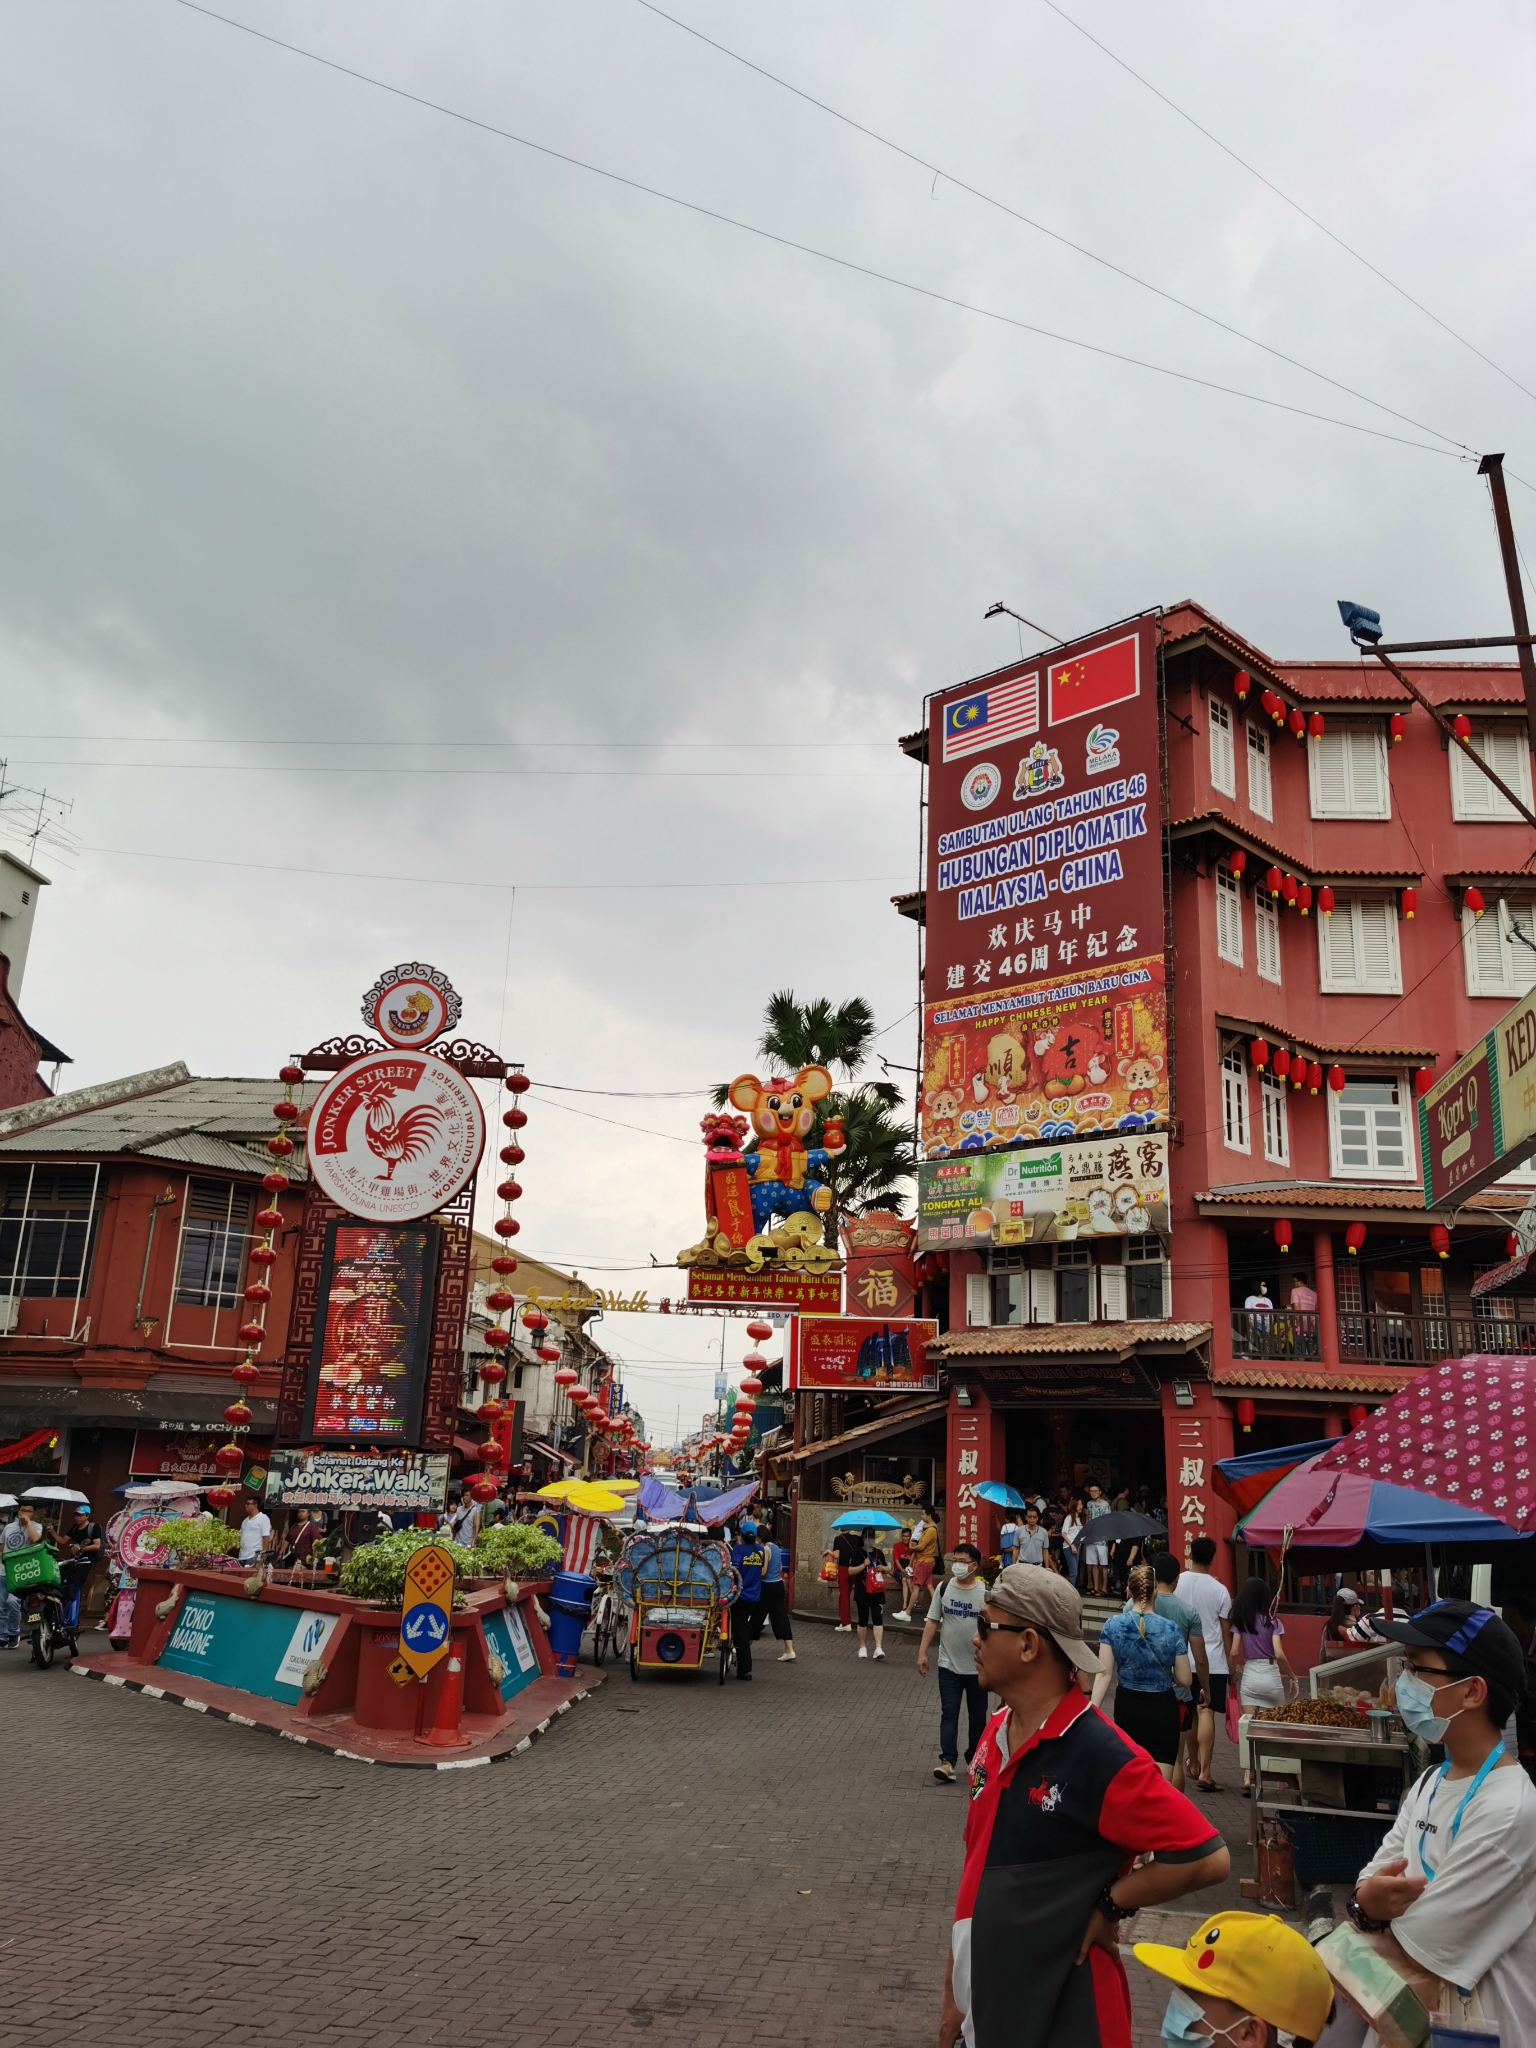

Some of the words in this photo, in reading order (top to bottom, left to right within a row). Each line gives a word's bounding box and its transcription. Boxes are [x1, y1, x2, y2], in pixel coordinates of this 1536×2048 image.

[1089, 751, 1117, 764] MELAKA
[939, 817, 1006, 854] SAMBUTAN
[1009, 804, 1053, 833] ULANG
[1055, 788, 1103, 820] TAHUN
[1106, 781, 1125, 805] KE
[1128, 775, 1145, 796] 46
[939, 838, 1031, 889] HUBUNGAN
[1036, 805, 1146, 862] DIPLOMATIK
[959, 871, 1046, 918] MALAYSIA
[1061, 851, 1122, 891] CHINA
[987, 903, 1092, 950] 欢庆马中
[934, 1005, 980, 1024] SELAMAT
[981, 992, 1046, 1014] MENYAMBUT
[1048, 983, 1085, 1001] TAHUN
[1088, 976, 1119, 993] BARU
[1121, 970, 1150, 985] CINA
[391, 1013, 410, 1030] JONKER
[412, 1015, 427, 1028] WALK
[975, 1016, 1005, 1029] HAPPY
[1009, 1007, 1052, 1022] CHINESE
[1056, 1002, 1077, 1013] NEW
[1081, 995, 1108, 1008] YEAR
[1059, 1035, 1080, 1069] 吉
[430, 1069, 469, 1108] HERITAGE
[322, 1085, 356, 1148] JONKER
[355, 1066, 417, 1089] STREET
[1438, 1086, 1465, 1142] Kopi
[461, 1110, 476, 1163] CULTURAL
[1007, 1167, 1018, 1176] Dr
[1021, 1162, 1058, 1175] Nutrition
[323, 1158, 352, 1196] WARISAN
[349, 1192, 377, 1211] DUNIA
[379, 1201, 419, 1213] UNESCO
[432, 1167, 464, 1200] WORLD
[922, 1199, 966, 1211] TONGKAT
[968, 1197, 983, 1207] ALI
[853, 1228, 910, 1249] 2020
[691, 1271, 725, 1281] Selamat
[774, 1273, 799, 1284] Tahun
[801, 1274, 821, 1285] Baru
[821, 1275, 840, 1285] Cina
[857, 1268, 898, 1309] 福
[519, 1285, 594, 1319] Jonker
[592, 1287, 651, 1312] Walk
[978, 1364, 1024, 1380] San
[1021, 1364, 1069, 1380] Shu
[1066, 1363, 1136, 1384] Gong
[205, 1422, 251, 1433] OCHADO
[313, 1456, 351, 1466] Selamat
[354, 1456, 388, 1468] Datang
[391, 1457, 404, 1467] Ke
[957, 1417, 979, 1510] 三叔公
[1178, 1420, 1206, 1526] 三叔公
[284, 1467, 365, 1490] Jonker
[372, 1468, 430, 1491] Walk
[282, 1492, 430, 1507] 欢迎来到马六甲鸡场街文化坊
[128, 1518, 150, 1536] KITTY
[13, 1558, 40, 1573] Grab
[14, 1567, 41, 1583] Food
[943, 1606, 979, 1618] Disneylan
[950, 1599, 973, 1611] Tokyo
[180, 1606, 215, 1632] TOKIO
[169, 1627, 214, 1656] MARINE
[373, 1633, 398, 1643] JONK
